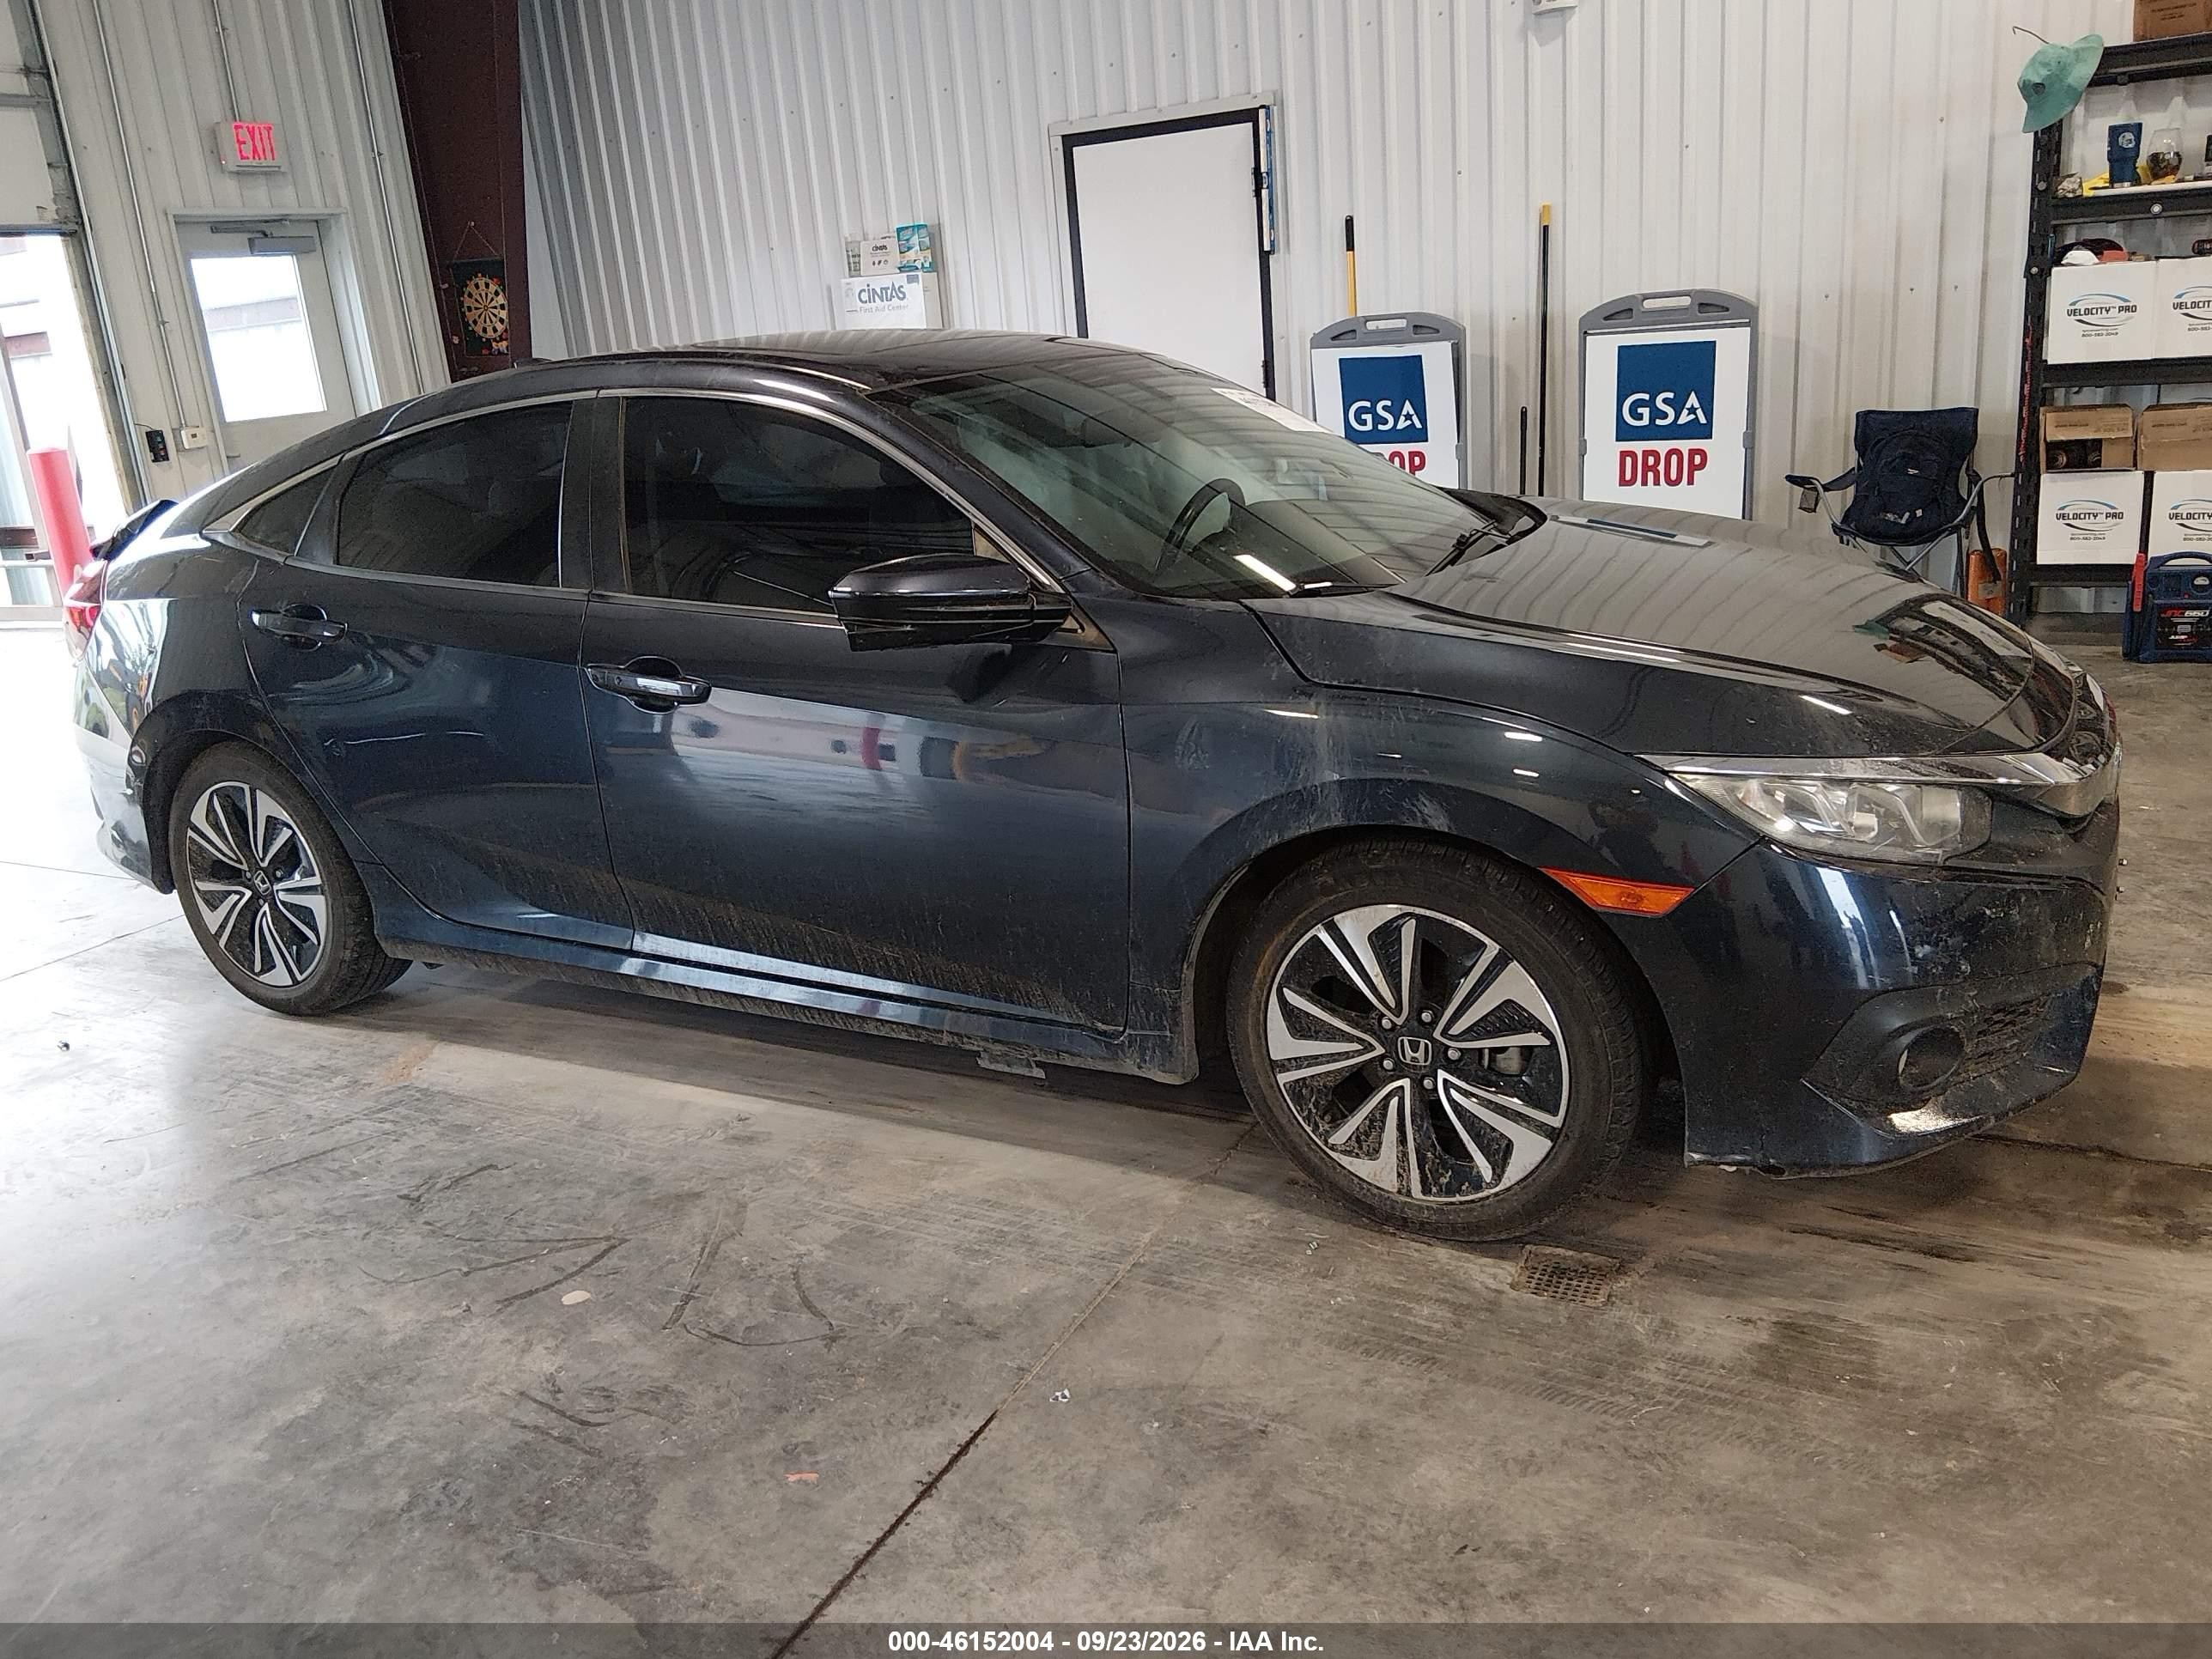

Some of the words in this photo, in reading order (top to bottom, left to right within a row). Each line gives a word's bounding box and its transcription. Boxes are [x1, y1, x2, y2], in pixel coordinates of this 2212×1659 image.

[234, 124, 276, 161] EXIT
[1348, 399, 1423, 431] GSA
[1622, 391, 1708, 426] GSA
[1389, 451, 1425, 476] OP
[1619, 448, 1708, 487] DROP
